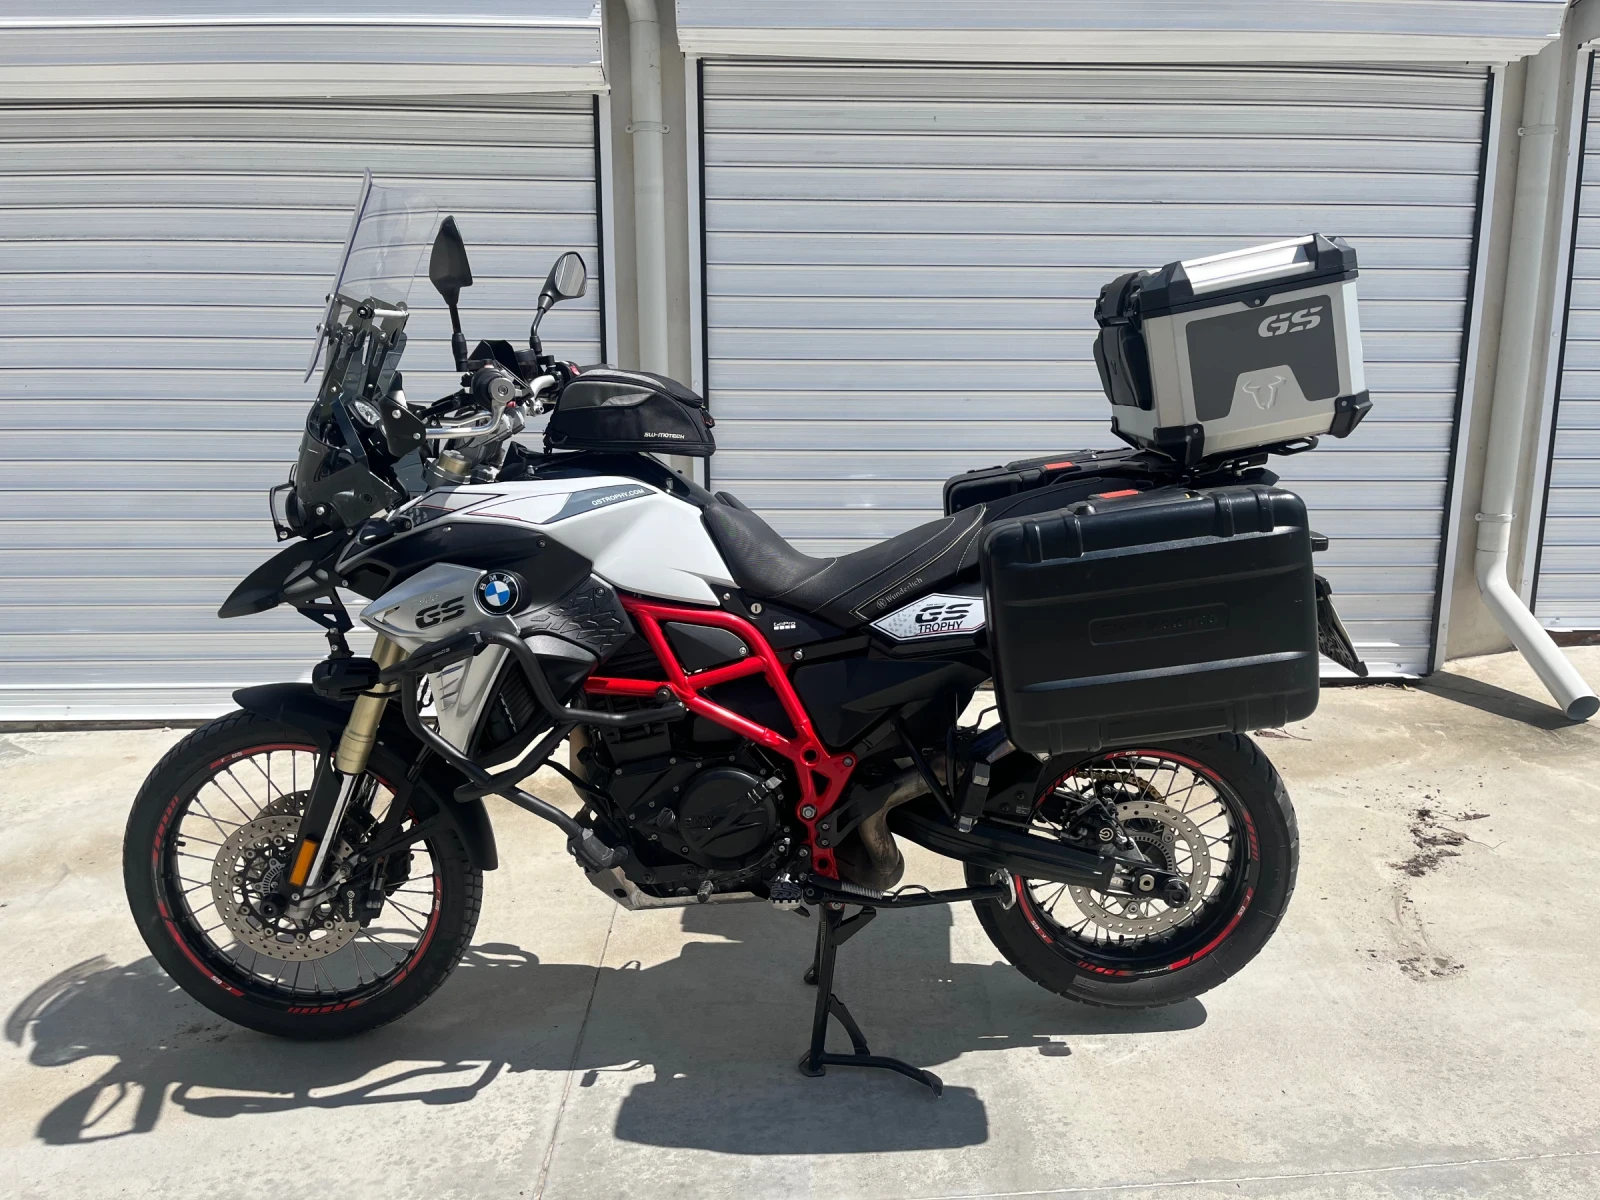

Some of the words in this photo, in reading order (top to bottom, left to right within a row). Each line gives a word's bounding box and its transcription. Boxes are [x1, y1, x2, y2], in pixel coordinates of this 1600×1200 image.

[1258, 306, 1323, 338] GS
[479, 574, 512, 591] BMW
[885, 577, 924, 603] Wunderlich
[415, 595, 465, 630] GS
[915, 602, 974, 624] GS
[918, 620, 964, 634] TROPHY
